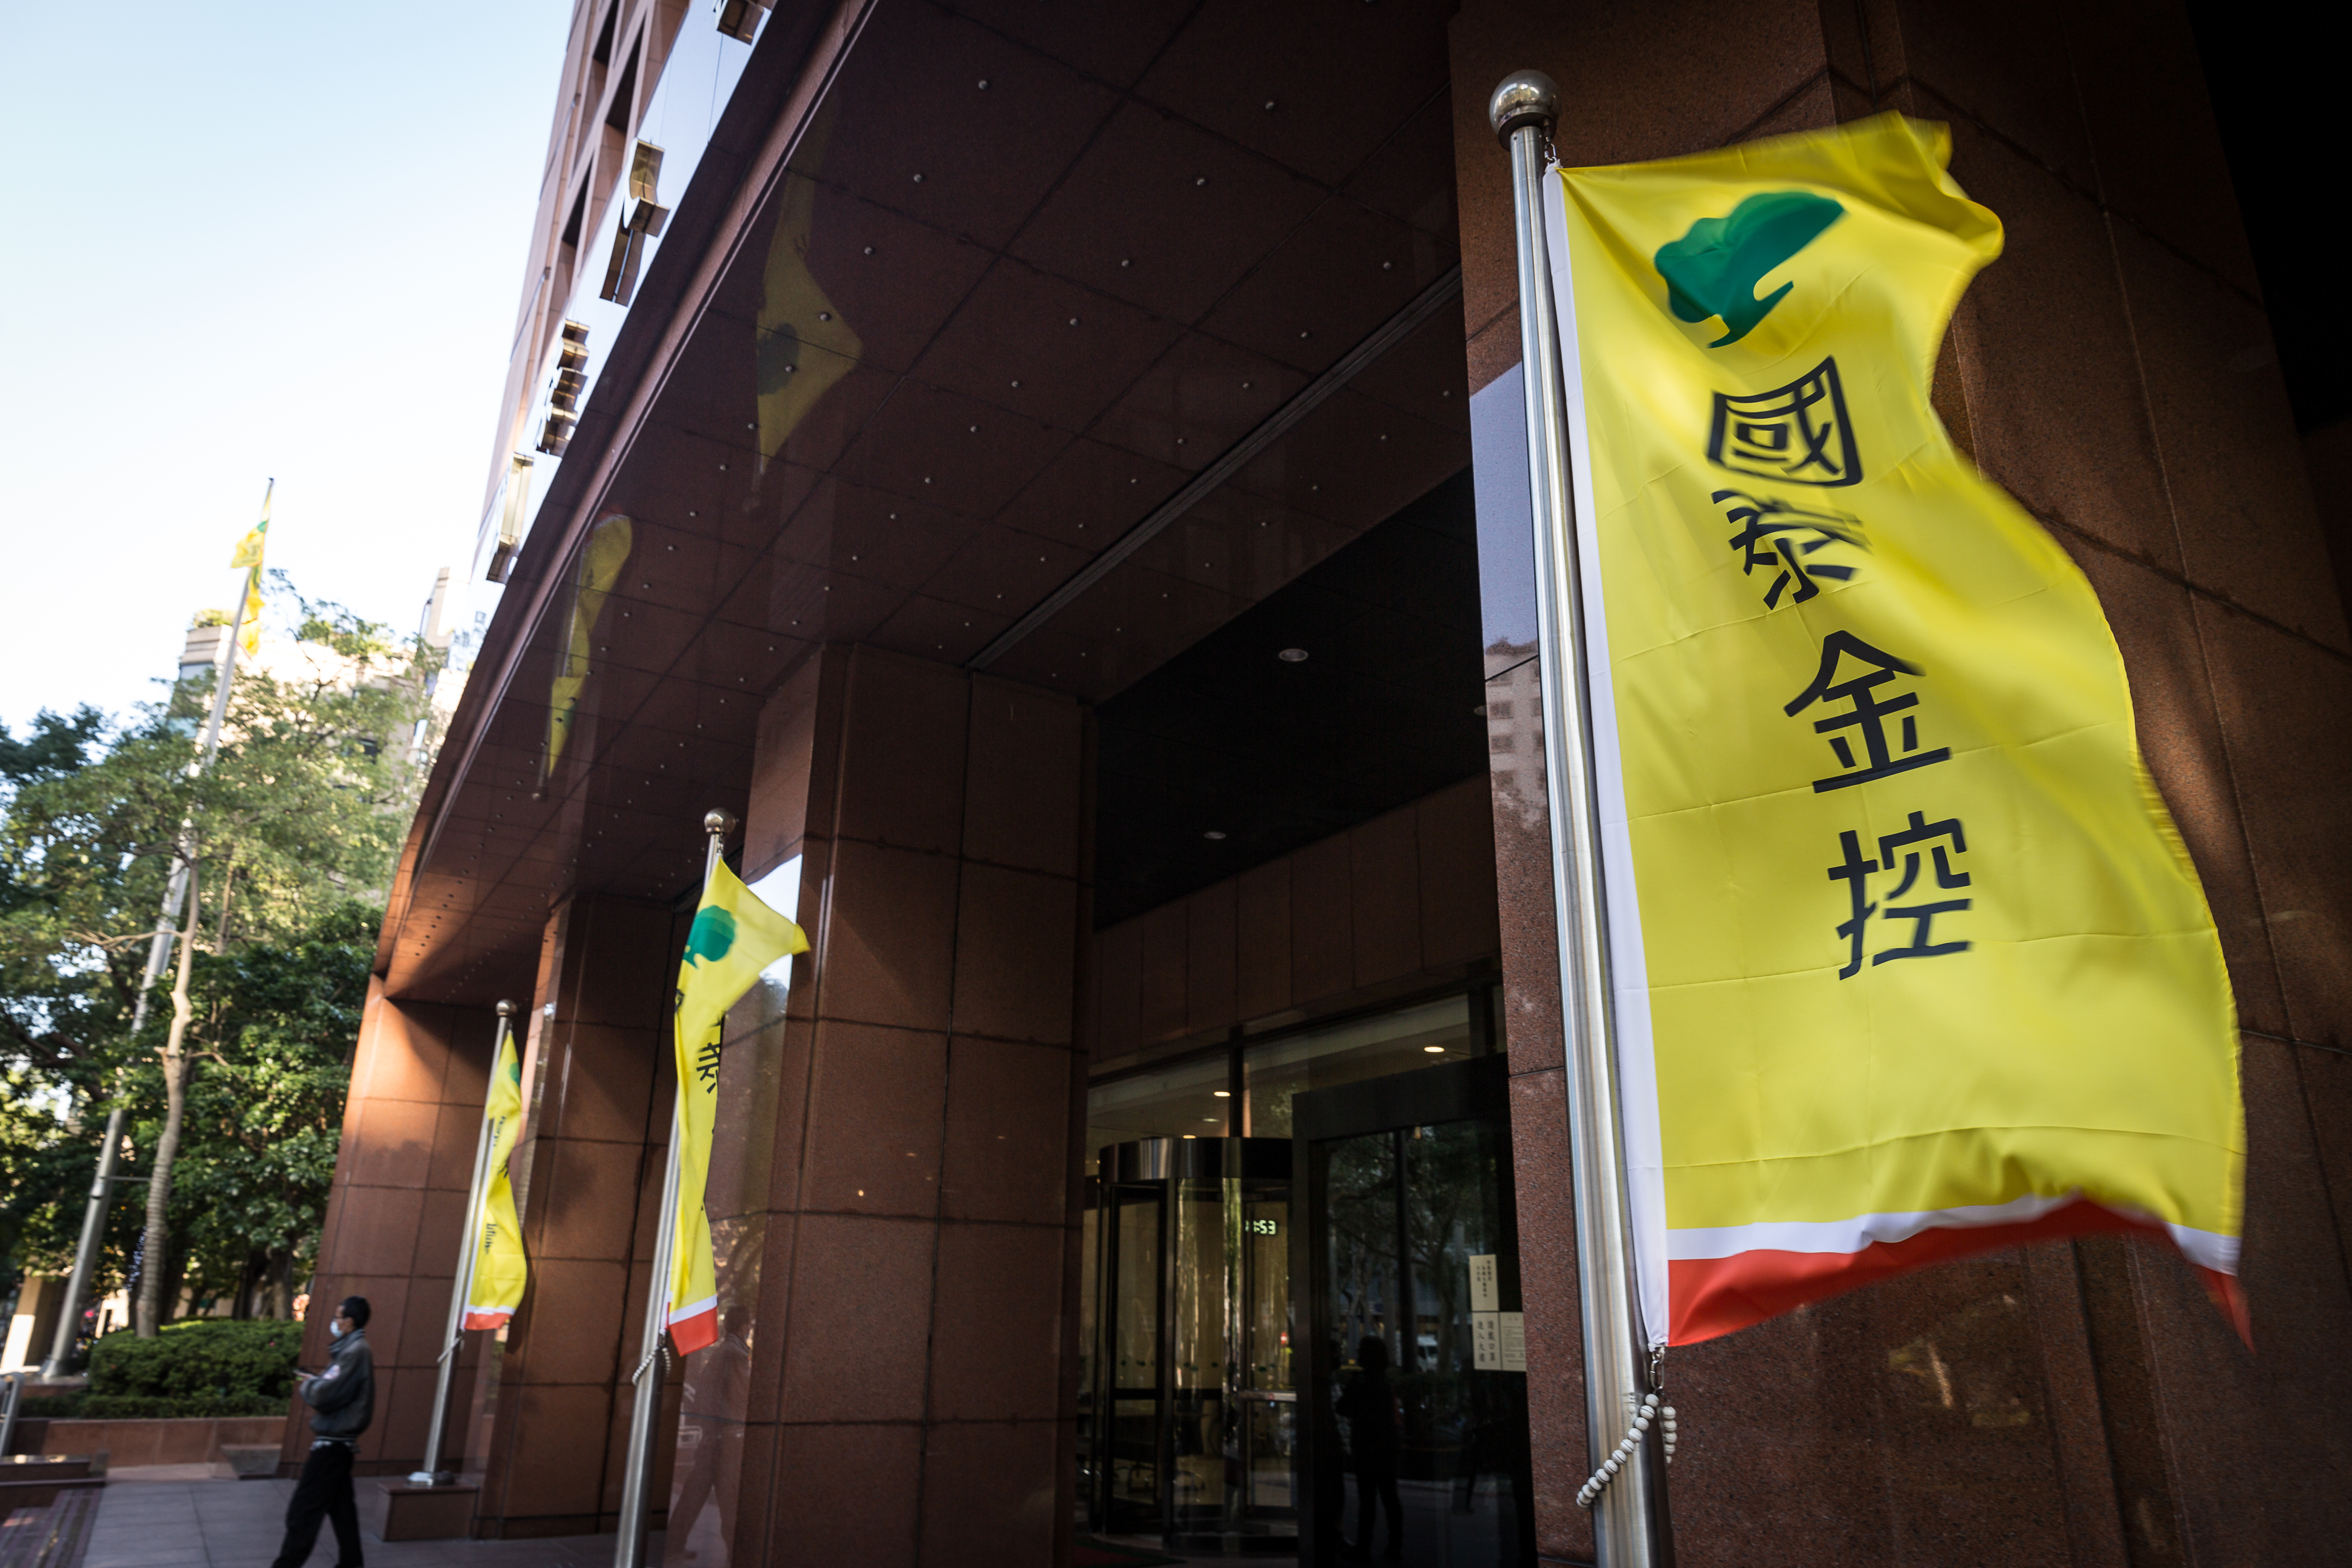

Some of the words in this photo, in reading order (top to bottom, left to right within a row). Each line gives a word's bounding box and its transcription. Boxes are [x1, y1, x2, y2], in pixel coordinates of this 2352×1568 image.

[1703, 354, 1974, 981] 國泰金控
[1245, 1220, 1276, 1234] 11:53
